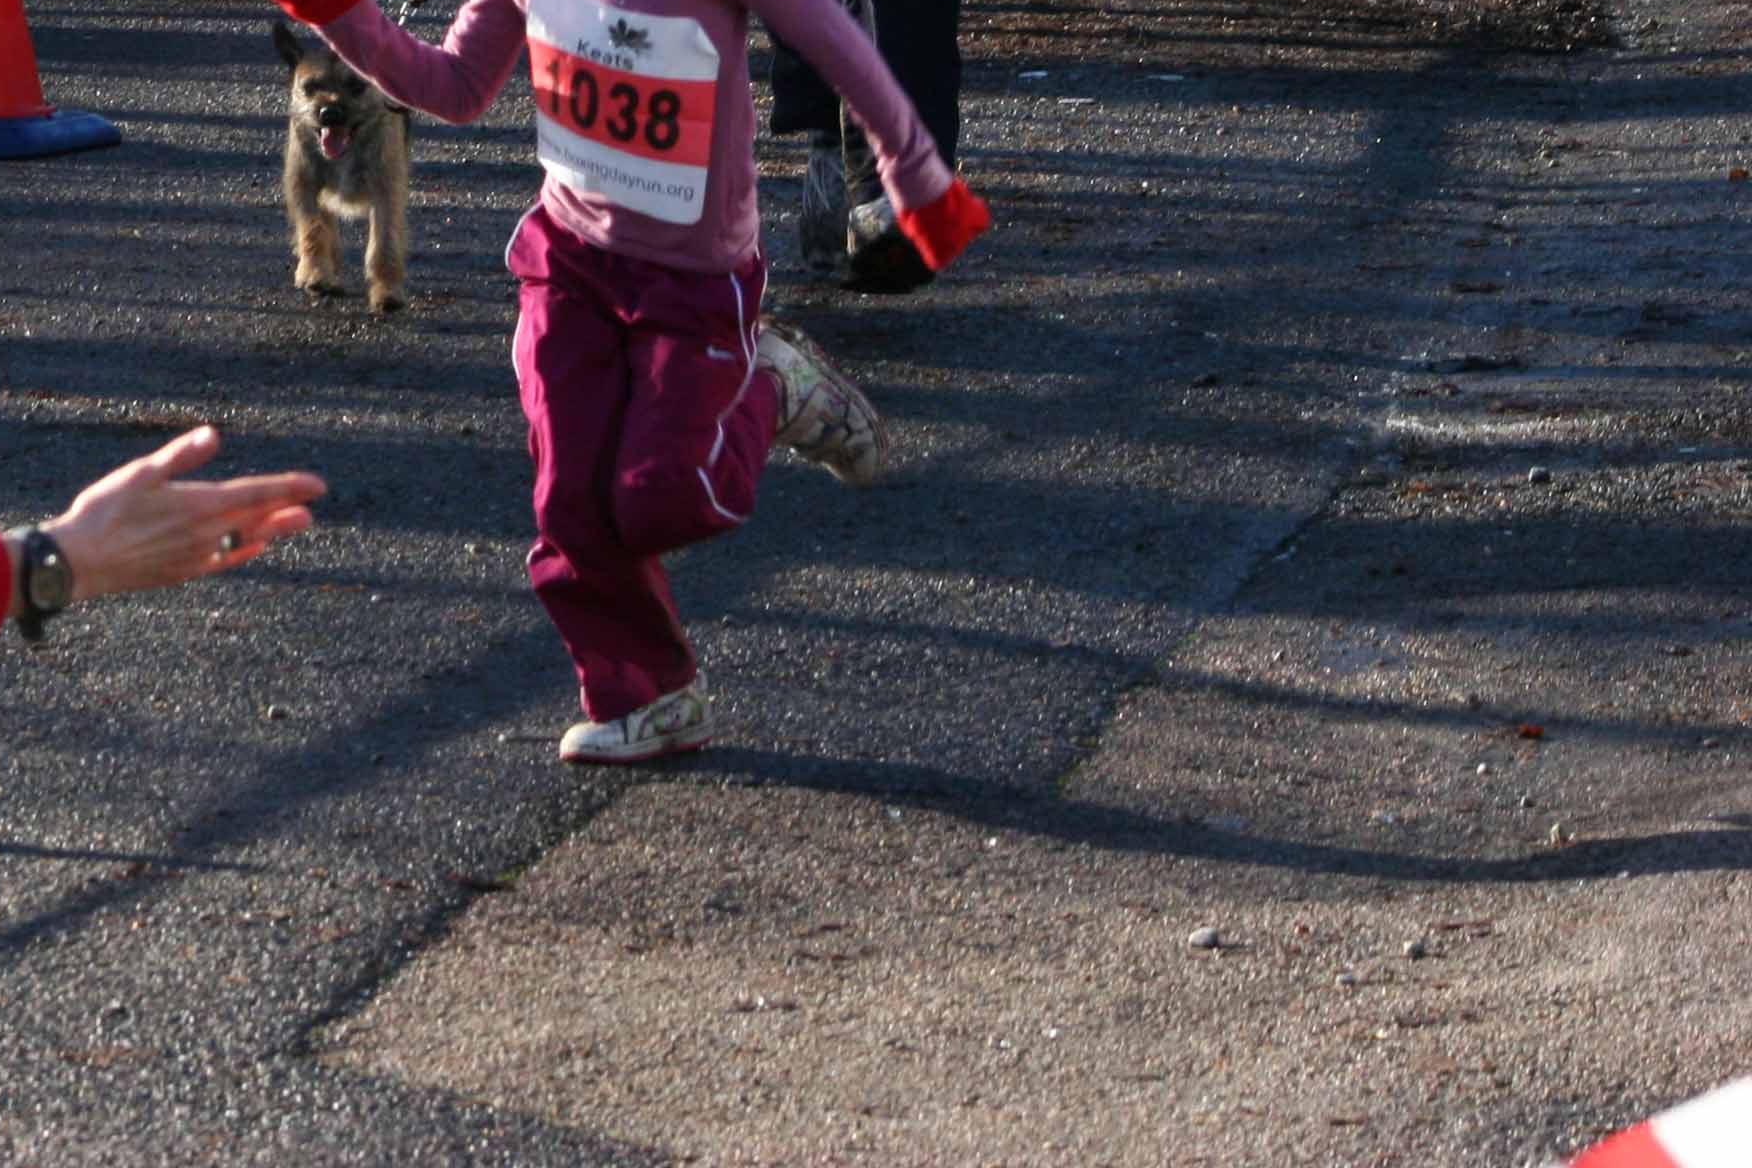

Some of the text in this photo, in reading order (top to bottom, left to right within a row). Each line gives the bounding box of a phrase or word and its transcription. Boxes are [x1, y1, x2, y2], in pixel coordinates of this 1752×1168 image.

[577, 39, 635, 70] Keats
[546, 59, 681, 150] 1038
[539, 134, 696, 201] .bingdayrun.org
